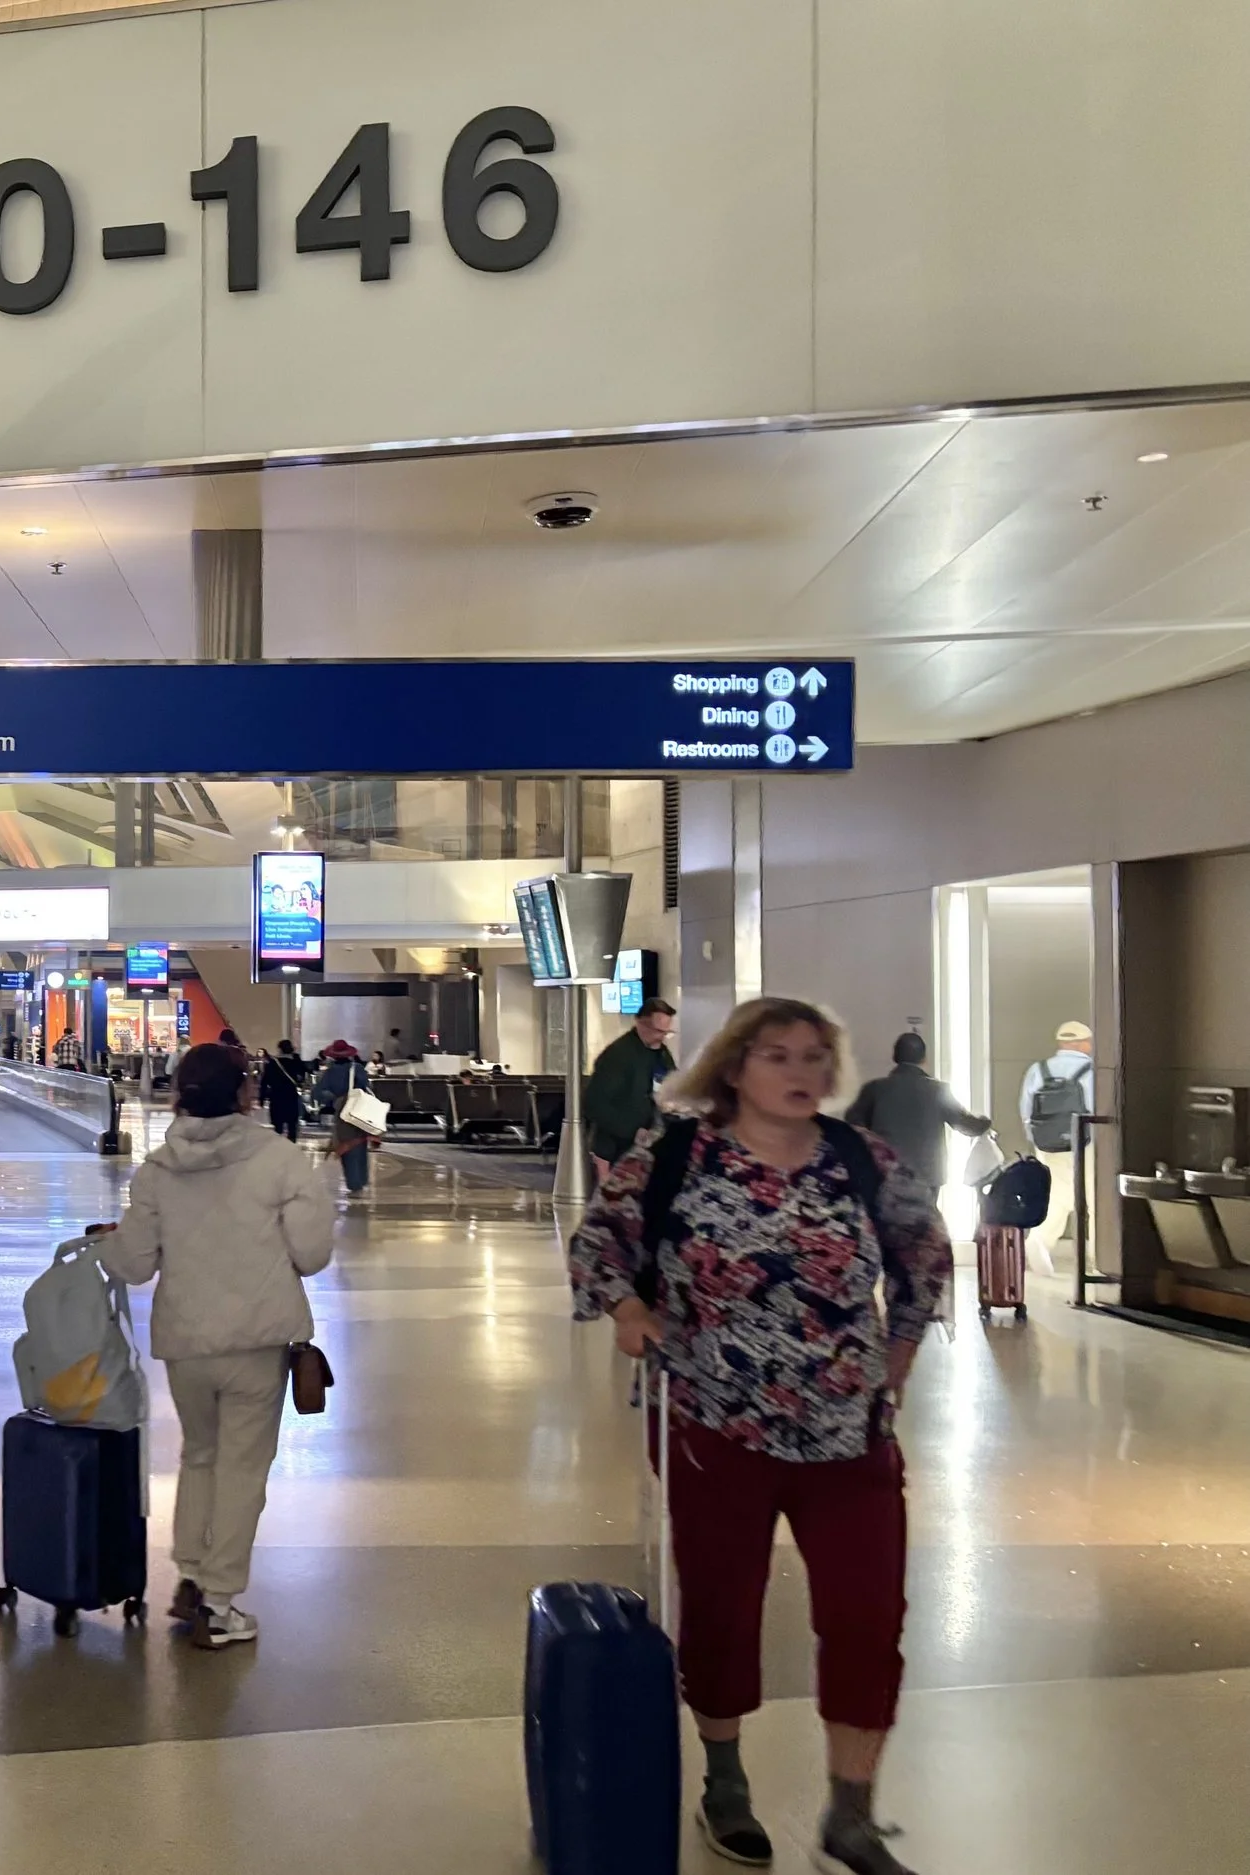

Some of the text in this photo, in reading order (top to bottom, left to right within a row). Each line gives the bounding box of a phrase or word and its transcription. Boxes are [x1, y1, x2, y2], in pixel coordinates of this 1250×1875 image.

[673, 673, 759, 694] Shopping
[702, 707, 759, 727] Dining
[662, 739, 759, 758] Restrooms
[178, 1015, 190, 1031] 131
